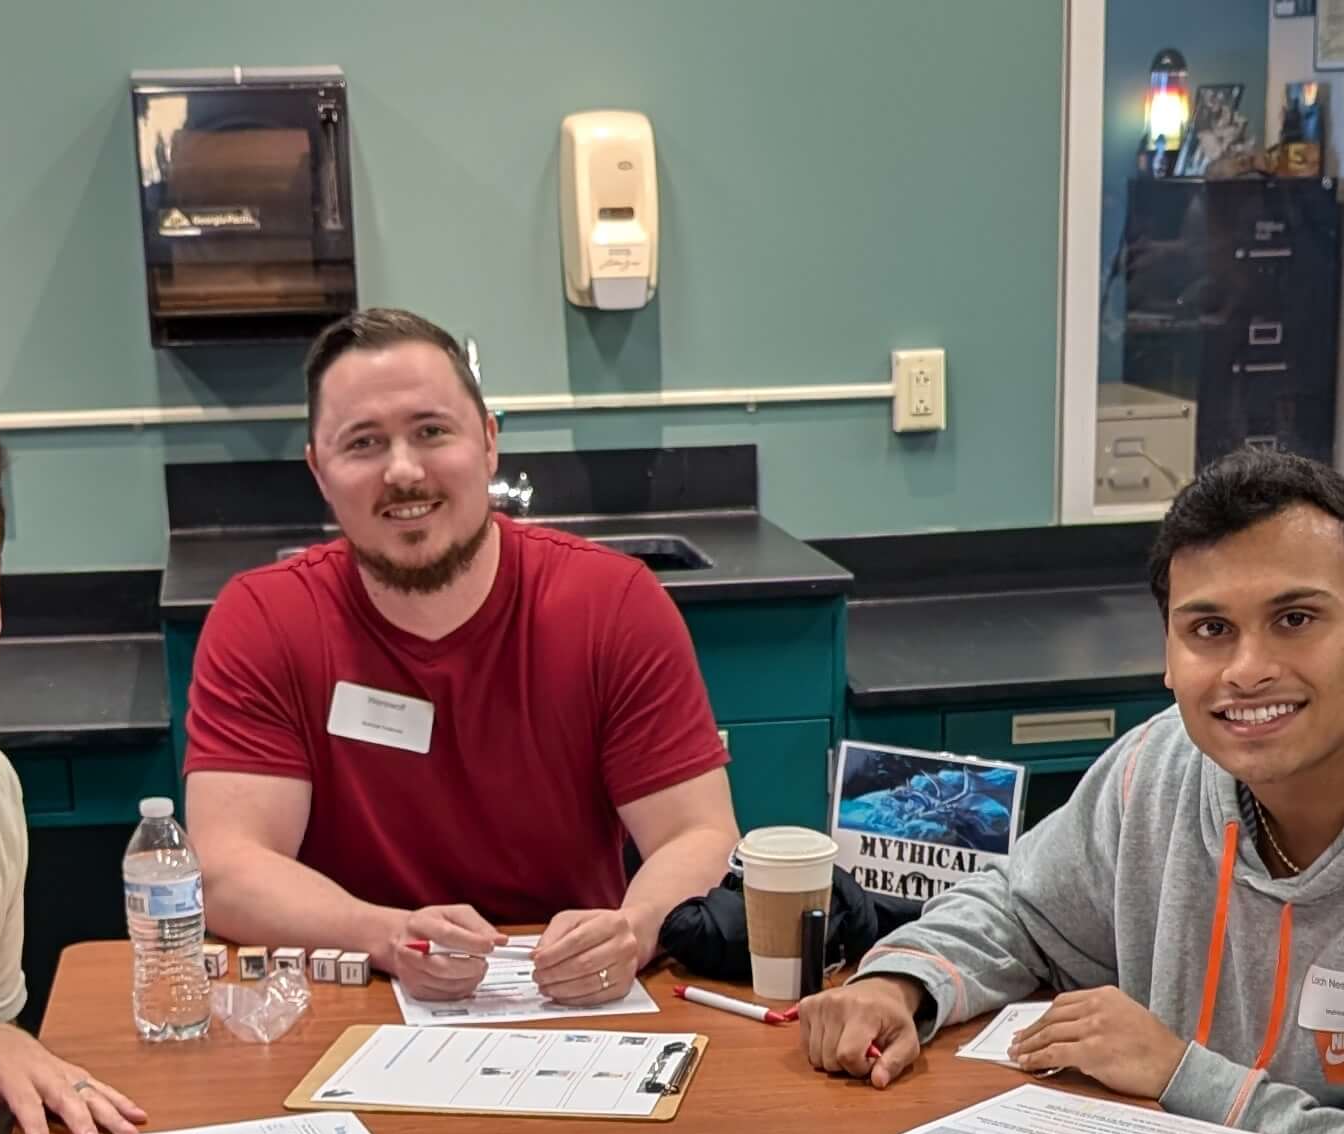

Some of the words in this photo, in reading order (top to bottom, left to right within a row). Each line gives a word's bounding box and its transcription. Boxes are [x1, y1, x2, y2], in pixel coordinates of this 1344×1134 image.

[859, 835, 981, 873] MYTHICAL
[851, 865, 955, 900] CREATU
[1311, 976, 1327, 986] Loch
